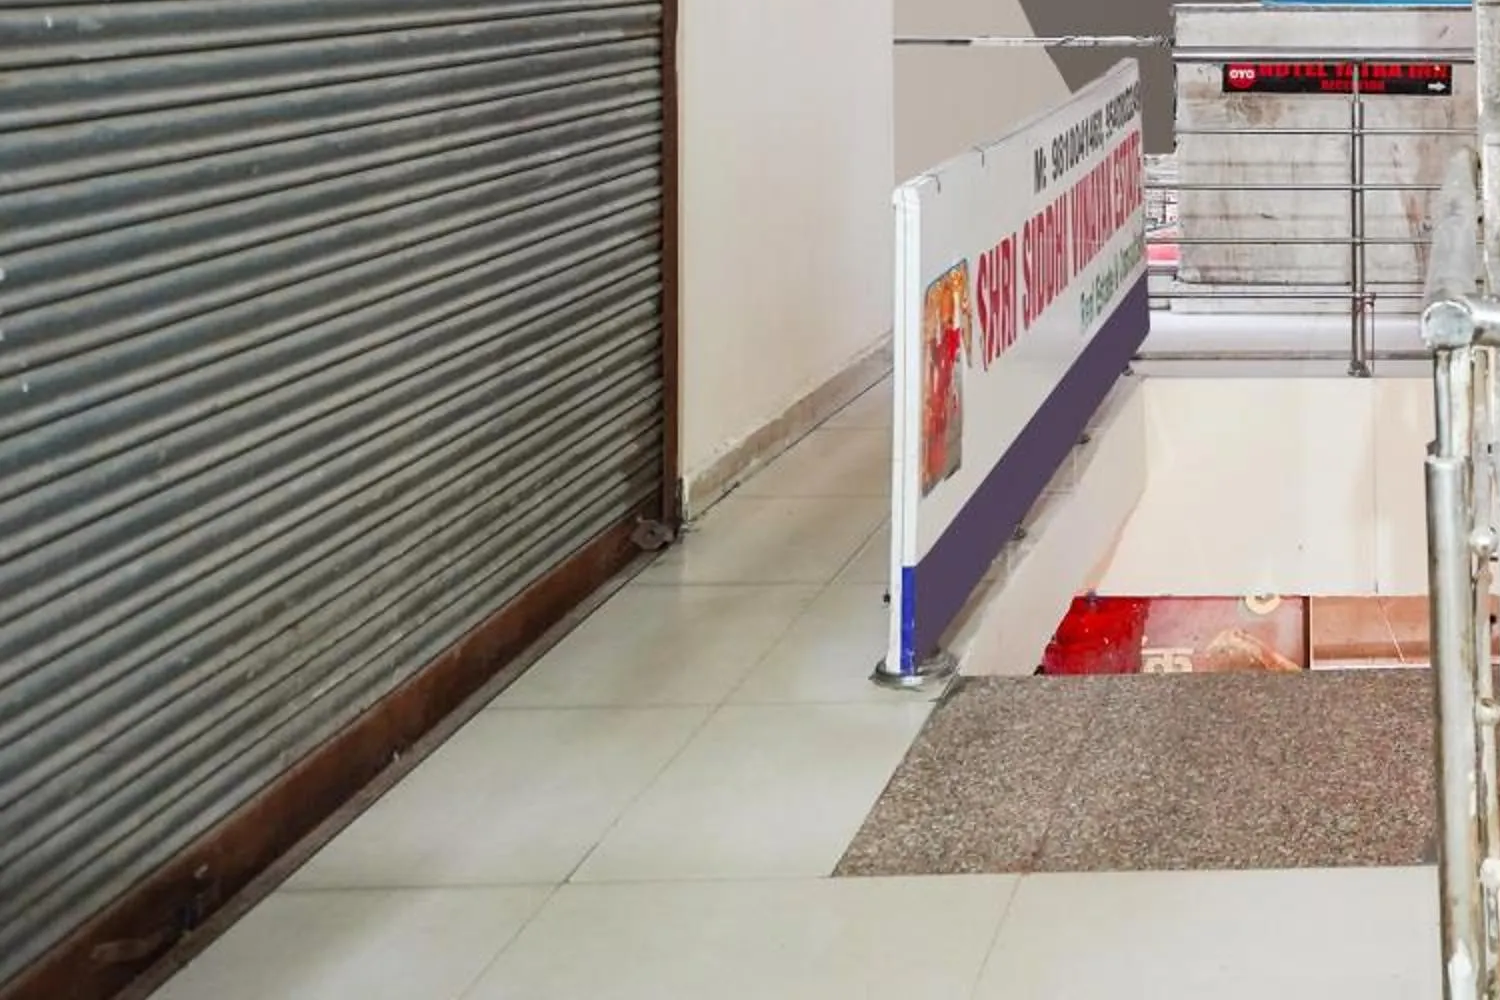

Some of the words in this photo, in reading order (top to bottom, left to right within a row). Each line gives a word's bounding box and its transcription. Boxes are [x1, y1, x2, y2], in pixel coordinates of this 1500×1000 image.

[1229, 68, 1255, 79] OYO
[1259, 62, 1326, 78] HOTEL
[1407, 63, 1448, 79] INN
[977, 232, 1018, 371] SHRI
[1023, 192, 1068, 331] SIDDHI
[1113, 130, 1142, 232] ESTATE
